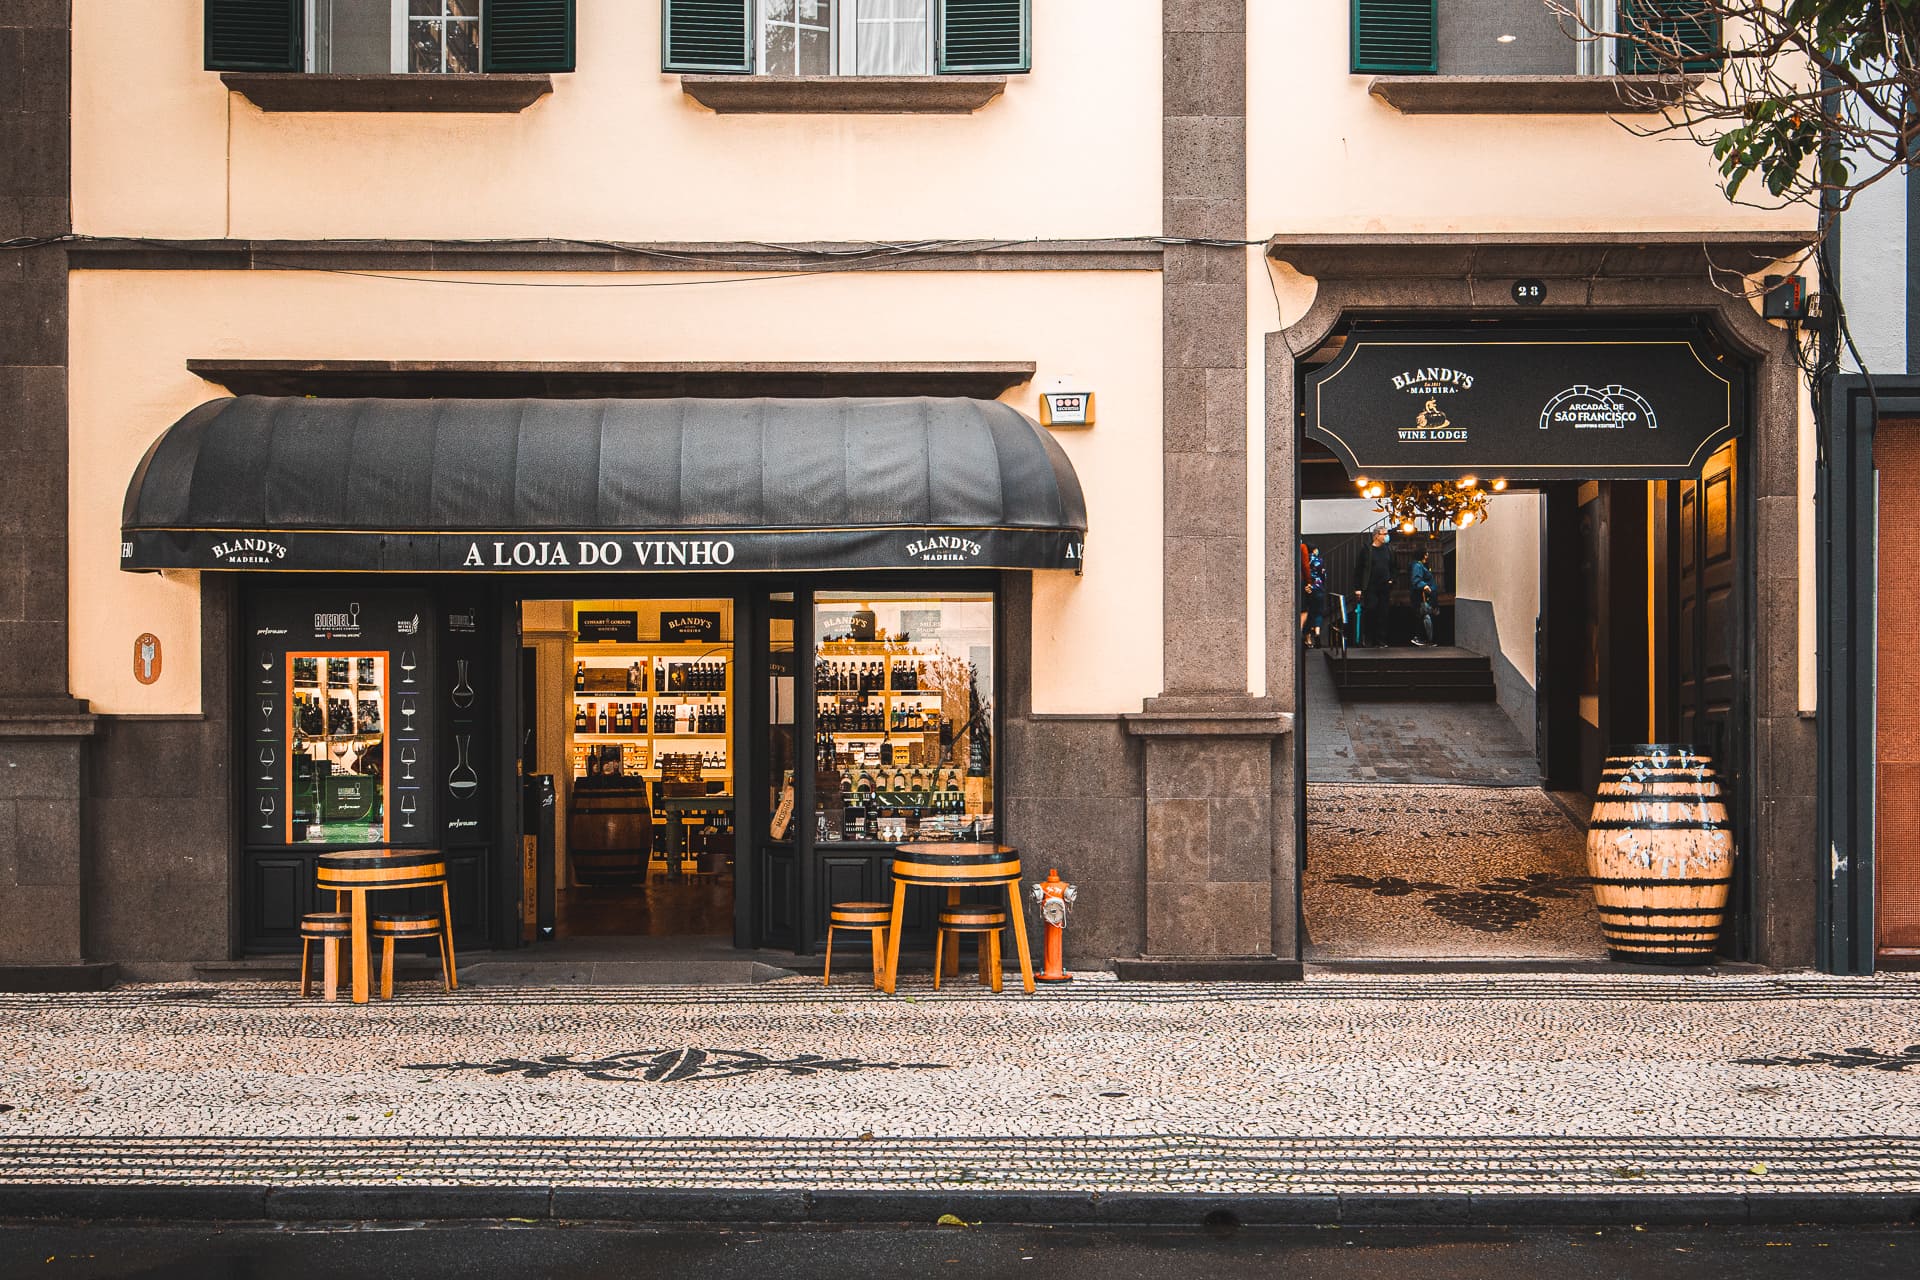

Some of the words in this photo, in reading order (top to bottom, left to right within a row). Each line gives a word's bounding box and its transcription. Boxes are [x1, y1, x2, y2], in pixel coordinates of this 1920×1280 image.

[1518, 286, 1539, 296] 28
[1392, 367, 1474, 390] BLANDY'S
[1569, 403, 1609, 411] ARCADAS
[1612, 403, 1625, 411] DE
[1554, 411, 1577, 422] SÃO
[1578, 411, 1637, 422] FRANCISCO
[1398, 430, 1427, 440] WINE
[1430, 430, 1468, 440] LODGE
[211, 538, 288, 559] BLANDY'S
[905, 535, 982, 556] BLANDY'S
[1065, 543, 1075, 559] A
[463, 542, 485, 566] A
[493, 541, 571, 566] LOJA
[578, 541, 623, 566] DO
[633, 540, 735, 566] VINHO
[923, 553, 965, 561] MADEIRA
[314, 613, 350, 628] RIEDEL
[668, 617, 713, 629] BLANDY'S
[823, 616, 868, 628] BLANDY'S
